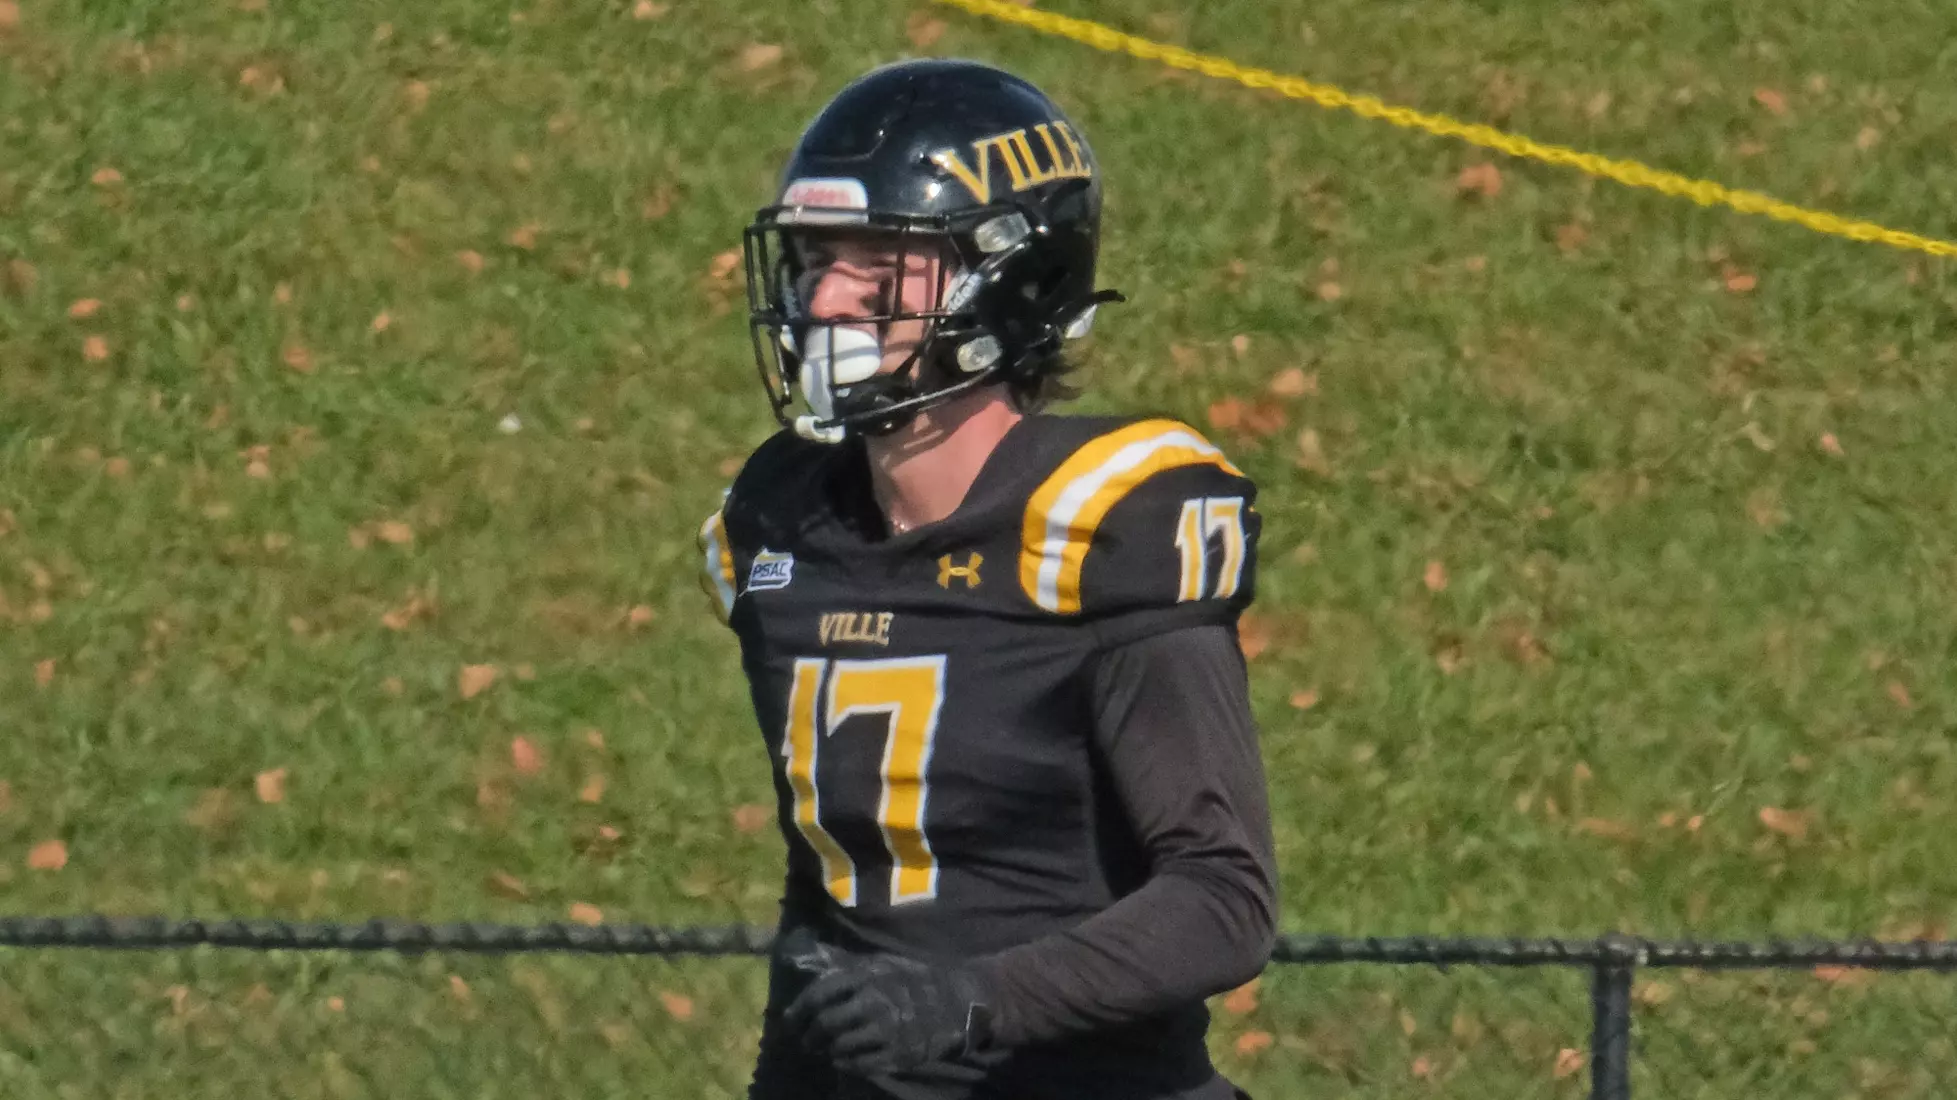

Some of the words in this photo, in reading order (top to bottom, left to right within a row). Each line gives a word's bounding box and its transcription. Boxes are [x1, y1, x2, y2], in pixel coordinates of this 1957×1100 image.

[928, 120, 1092, 205] VILLE
[752, 562, 789, 578] PSAC
[1174, 496, 1247, 604] 17
[819, 611, 895, 647] VILLE
[781, 654, 947, 908] 17
